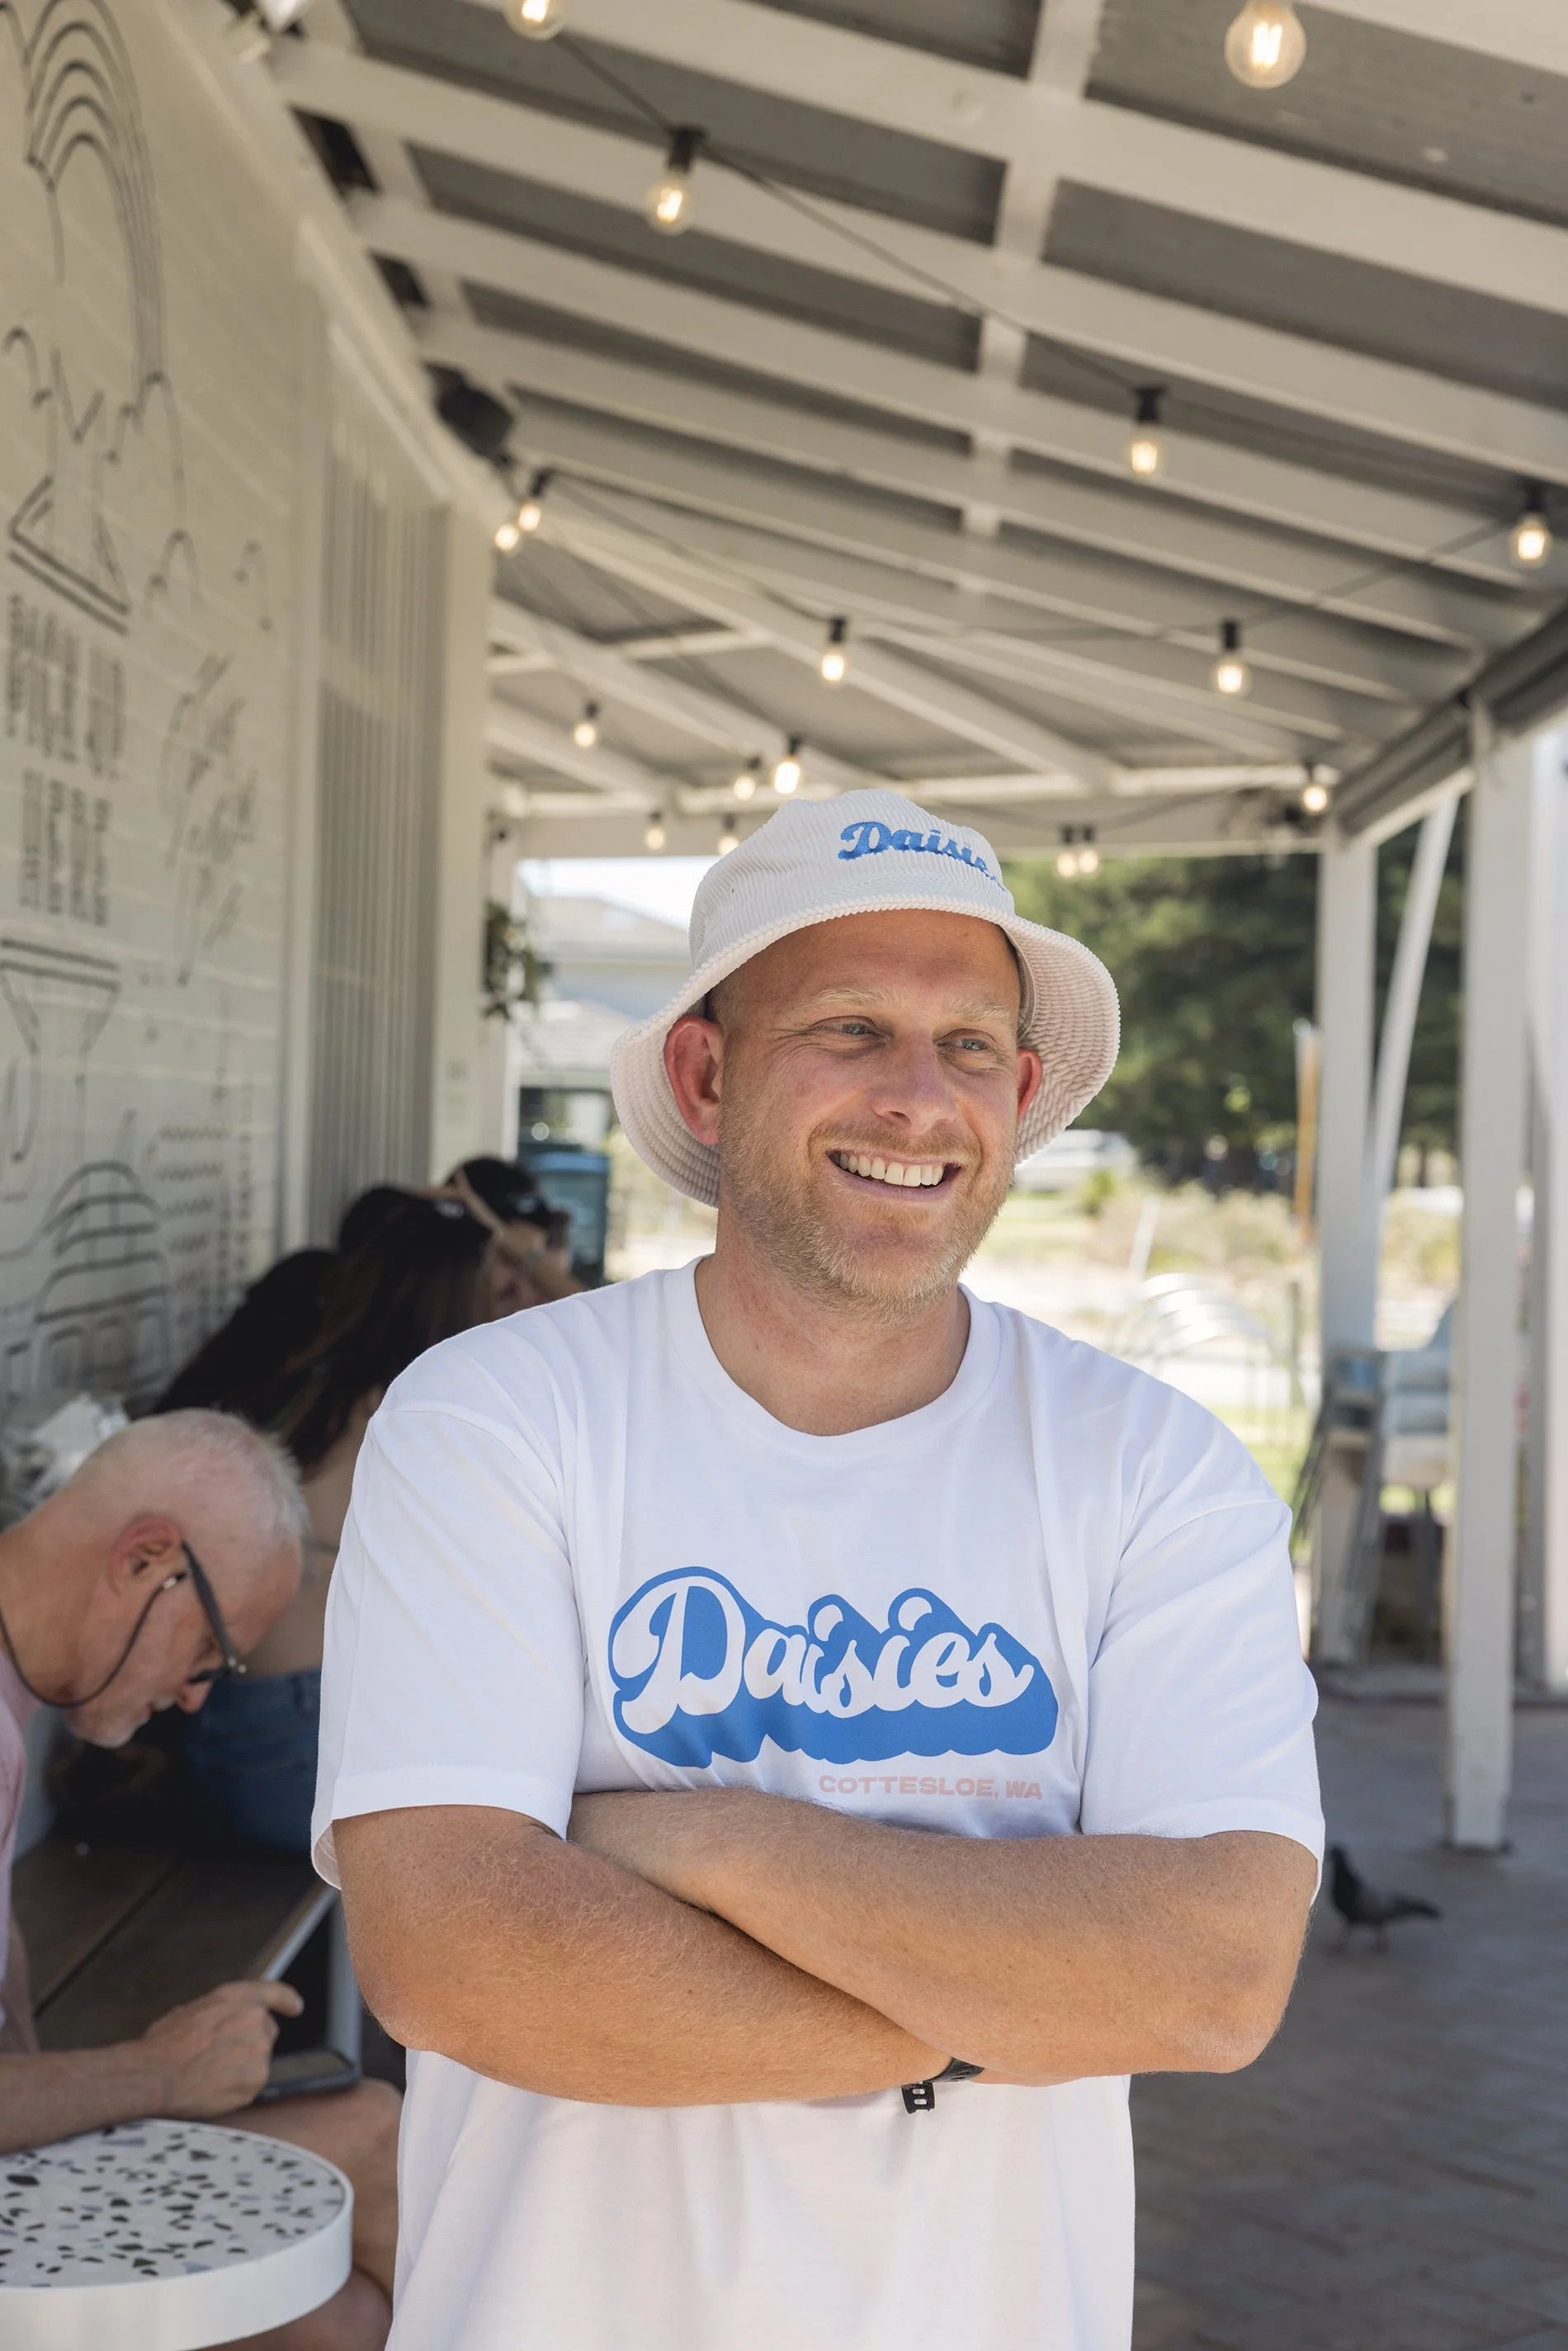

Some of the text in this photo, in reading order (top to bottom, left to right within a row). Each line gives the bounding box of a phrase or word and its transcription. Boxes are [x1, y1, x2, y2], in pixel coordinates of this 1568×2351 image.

[838, 821, 1005, 891] Daisi
[612, 1575, 1035, 1735] Daisies
[819, 1775, 1043, 1800] COTTESLOE, WA
